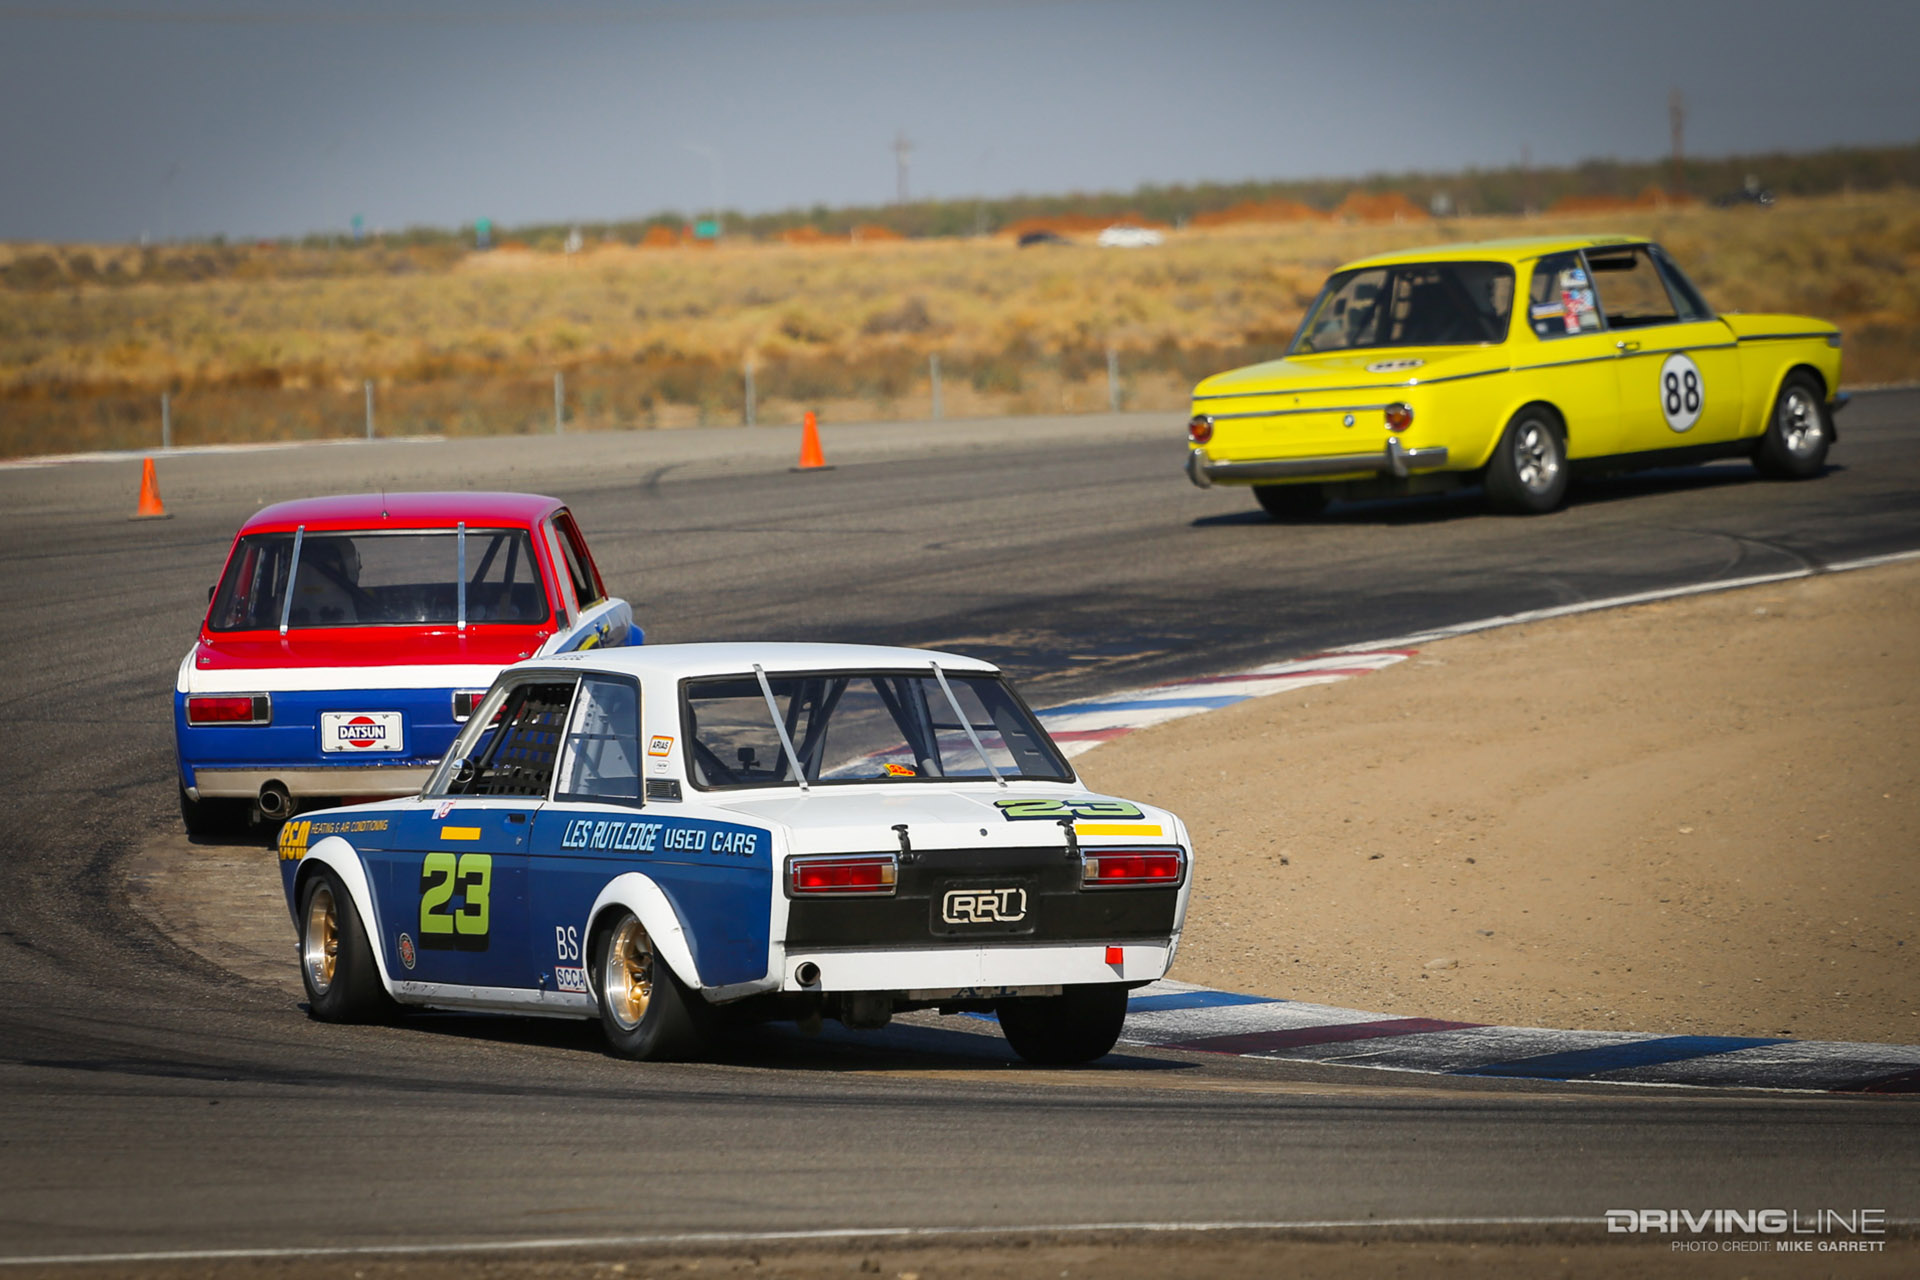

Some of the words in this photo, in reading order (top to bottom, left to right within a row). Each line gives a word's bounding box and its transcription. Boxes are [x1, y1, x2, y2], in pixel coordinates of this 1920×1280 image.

[1665, 370, 1700, 415] 88
[339, 726, 384, 738] DATSUN
[993, 799, 1145, 821] 23
[562, 819, 593, 848] LES
[590, 822, 663, 852] RUTLEDGE
[664, 828, 707, 850] USED
[711, 831, 757, 854] CARS
[421, 852, 492, 935] 23
[556, 925, 579, 961] BS
[557, 968, 585, 987] SCCA
